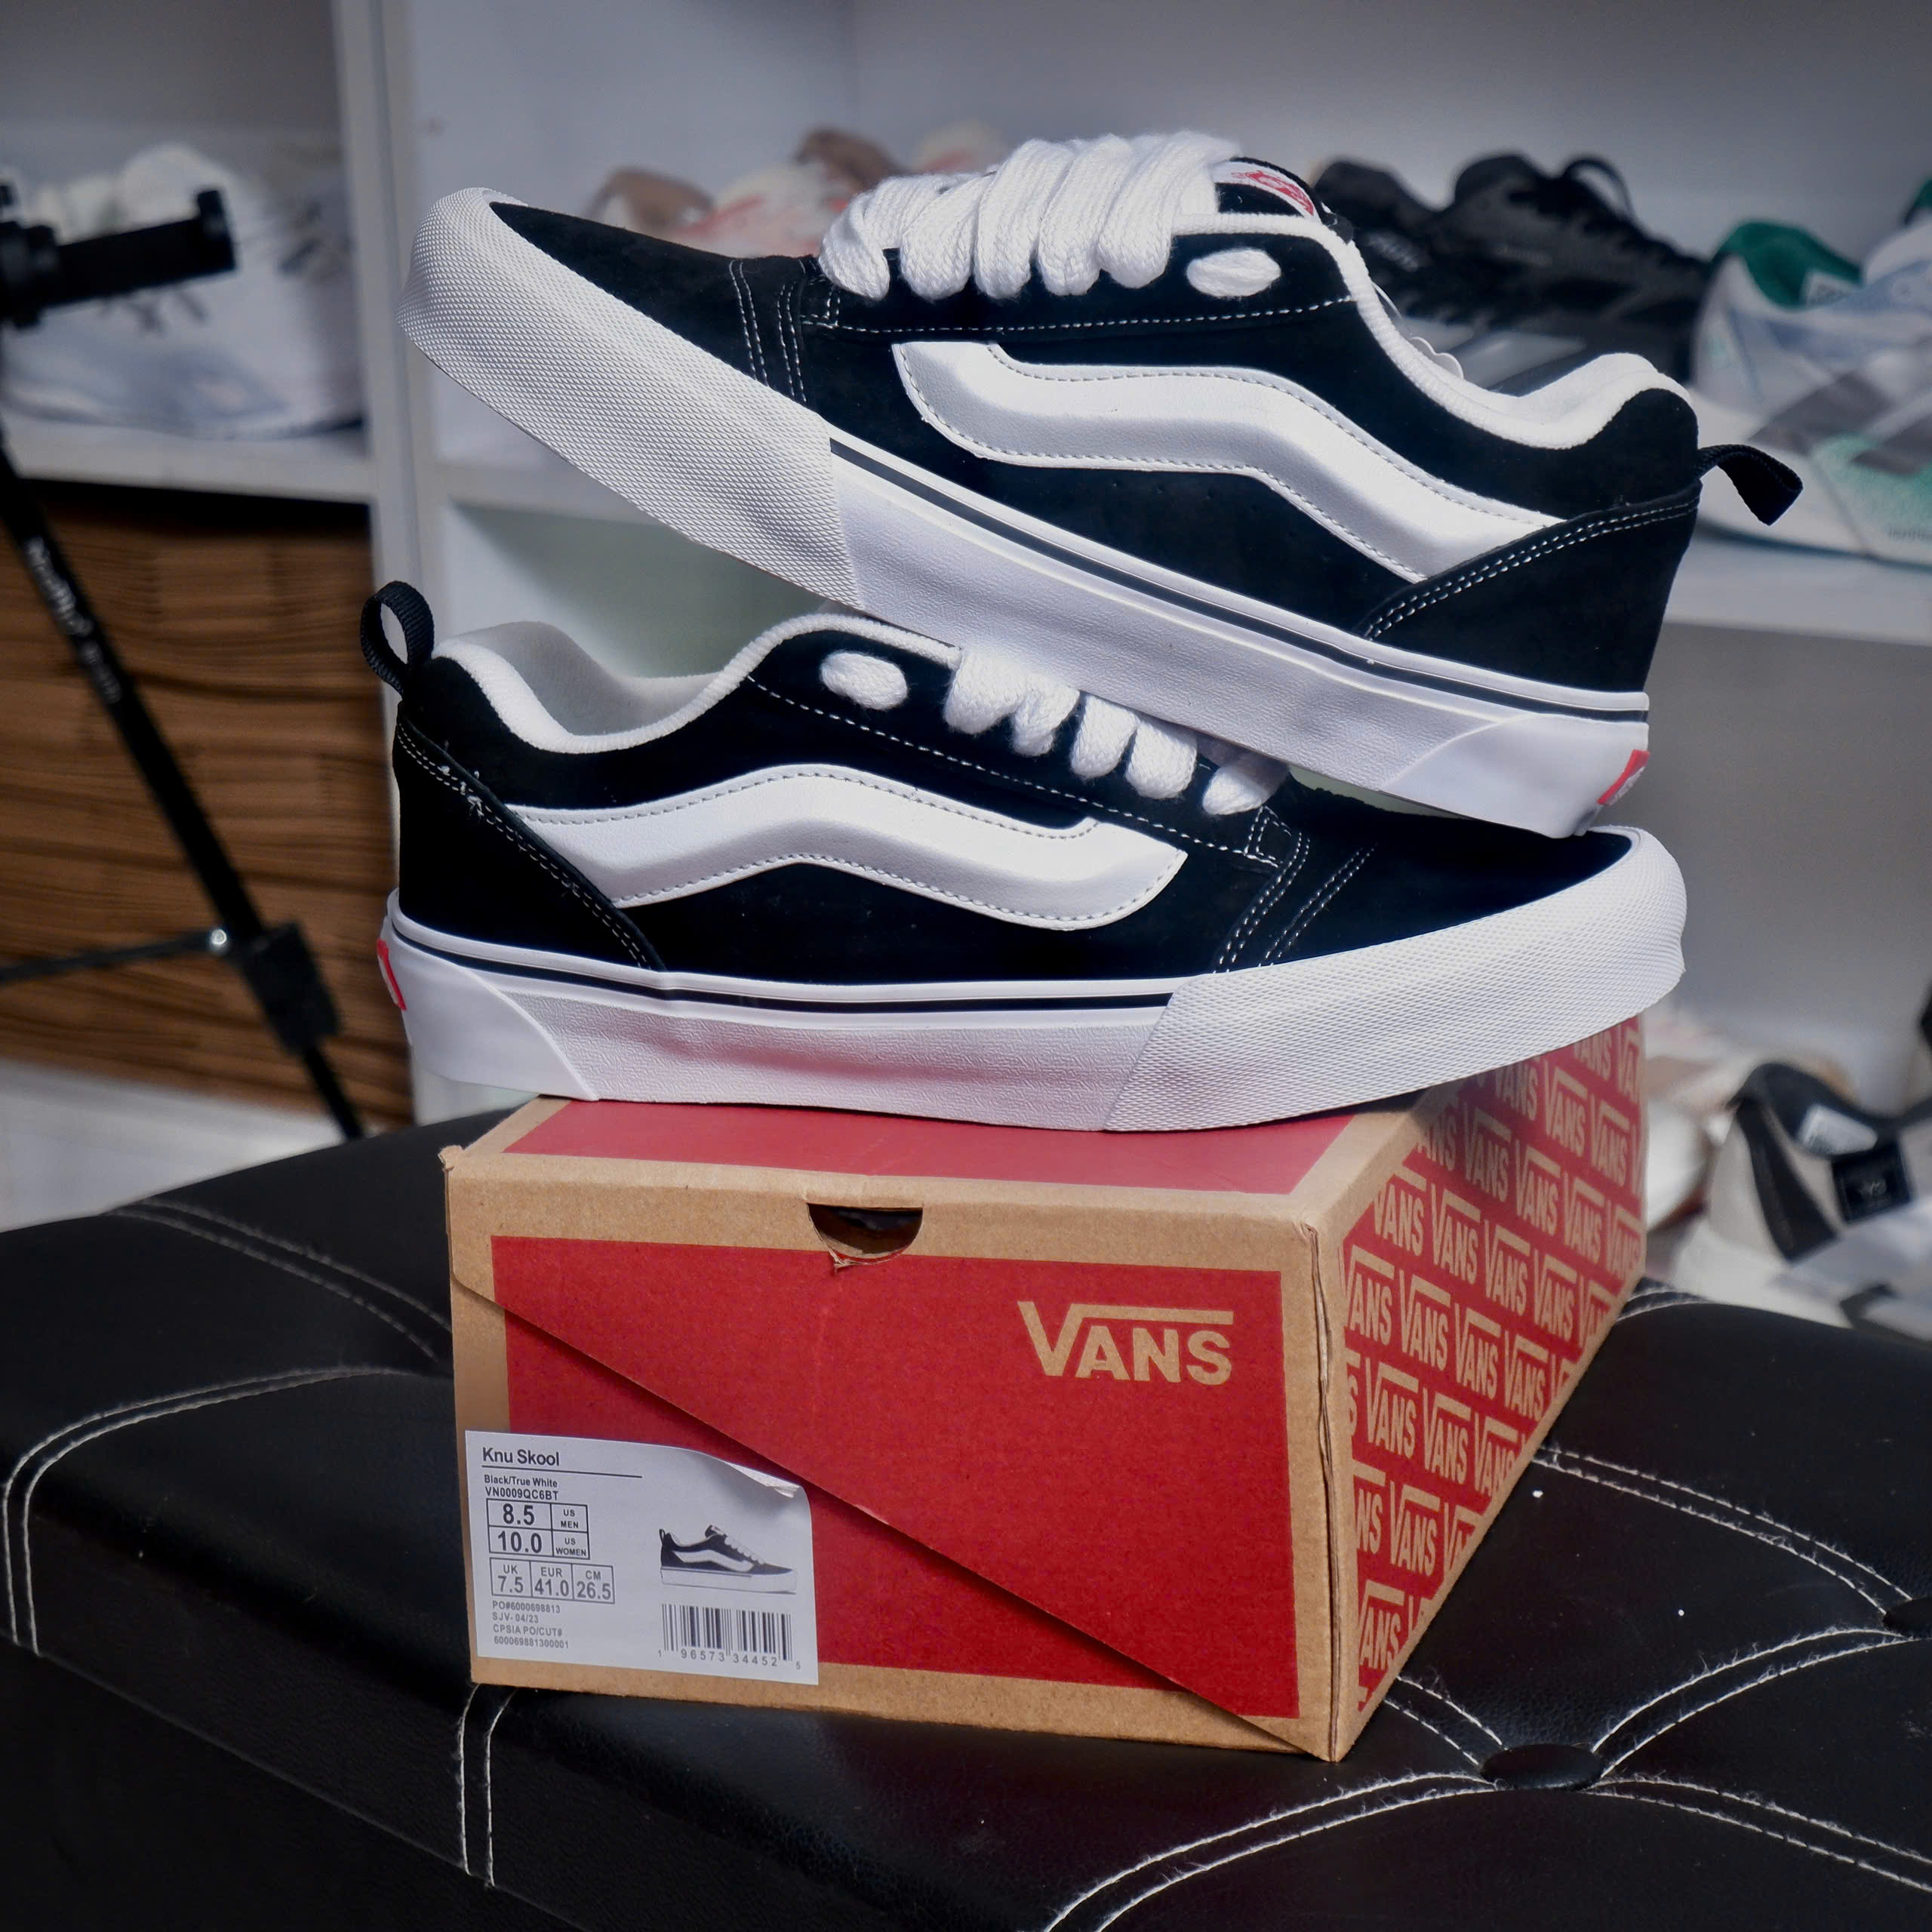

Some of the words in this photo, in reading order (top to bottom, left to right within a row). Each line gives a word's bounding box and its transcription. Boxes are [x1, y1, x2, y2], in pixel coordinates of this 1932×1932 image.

[1544, 1059, 1588, 1157] VANS
[1591, 1094, 1630, 1186] VANS
[1464, 1102, 1512, 1201] VANS
[1515, 1138, 1561, 1236] VANS
[1564, 1171, 1605, 1264] VANS
[1431, 1183, 1481, 1284] VANS
[1484, 1219, 1531, 1316] VANS
[1534, 1248, 1577, 1342] VANS
[1017, 1301, 1234, 1386] VANS
[1399, 1269, 1451, 1371] VANS
[1455, 1303, 1501, 1399] VANS
[1505, 1330, 1549, 1422] VANS
[1365, 1358, 1419, 1459] VANS
[1423, 1387, 1471, 1484] VANS
[483, 1447, 513, 1463] Knu
[517, 1448, 560, 1466] Skool
[485, 1474, 531, 1487] Black/True
[532, 1477, 558, 1487] White
[485, 1486, 559, 1500] VN0009QC6BT
[503, 1503, 535, 1525] 8.5
[561, 1520, 579, 1528] MEN
[1389, 1479, 1440, 1577] VANS
[497, 1531, 543, 1553] 10.0
[555, 1547, 586, 1556] WOMEN
[503, 1564, 518, 1574] UK
[540, 1567, 563, 1577] EUR
[585, 1571, 601, 1580] CM
[497, 1575, 524, 1593] 7.5
[534, 1578, 569, 1597] 41.0
[577, 1581, 611, 1600] 26.5
[515, 1614, 539, 1623] 04/23
[493, 1623, 521, 1635] CPSIA
[523, 1626, 563, 1637] PO/CUT#
